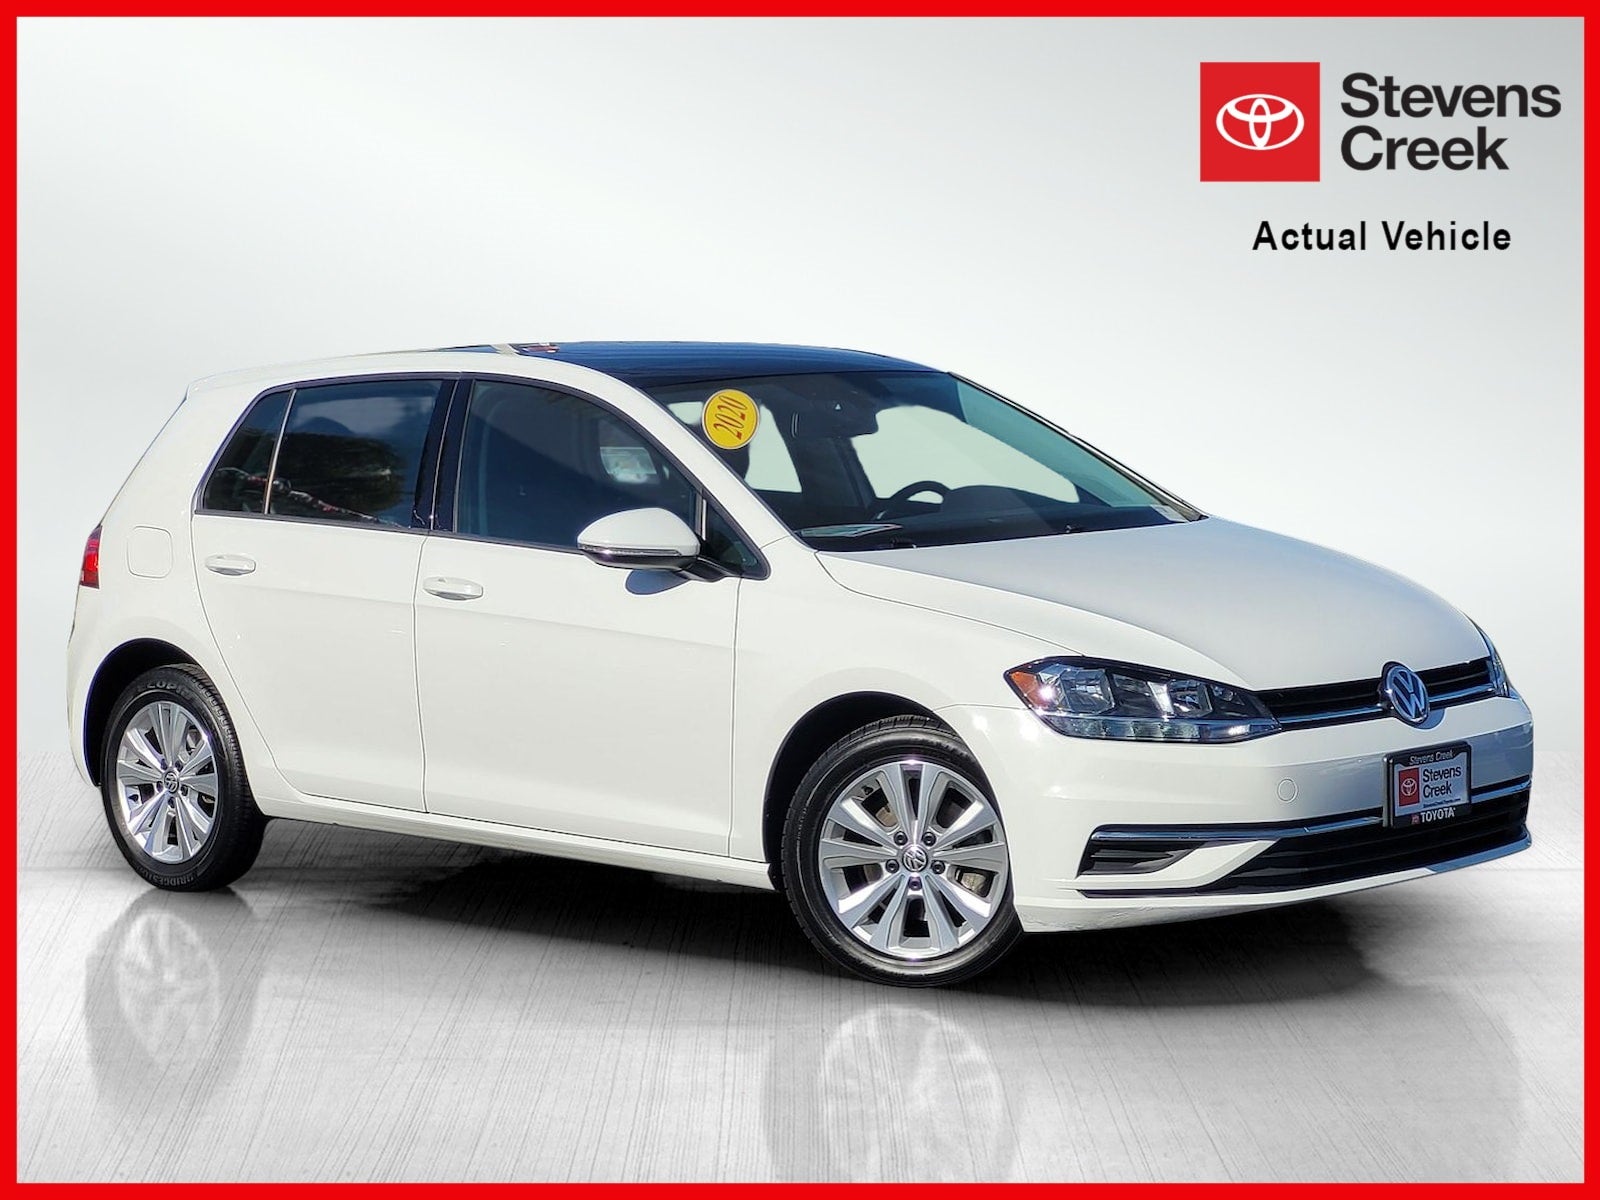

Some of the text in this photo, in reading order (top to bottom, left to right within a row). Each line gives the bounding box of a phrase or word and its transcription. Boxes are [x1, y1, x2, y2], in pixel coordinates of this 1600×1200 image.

[713, 395, 748, 440] 2020
[1409, 749, 1454, 765] Stevens Creek
[1423, 766, 1462, 782] Stevens
[1423, 781, 1452, 798] Creek
[1421, 807, 1455, 823] TOYOTA
